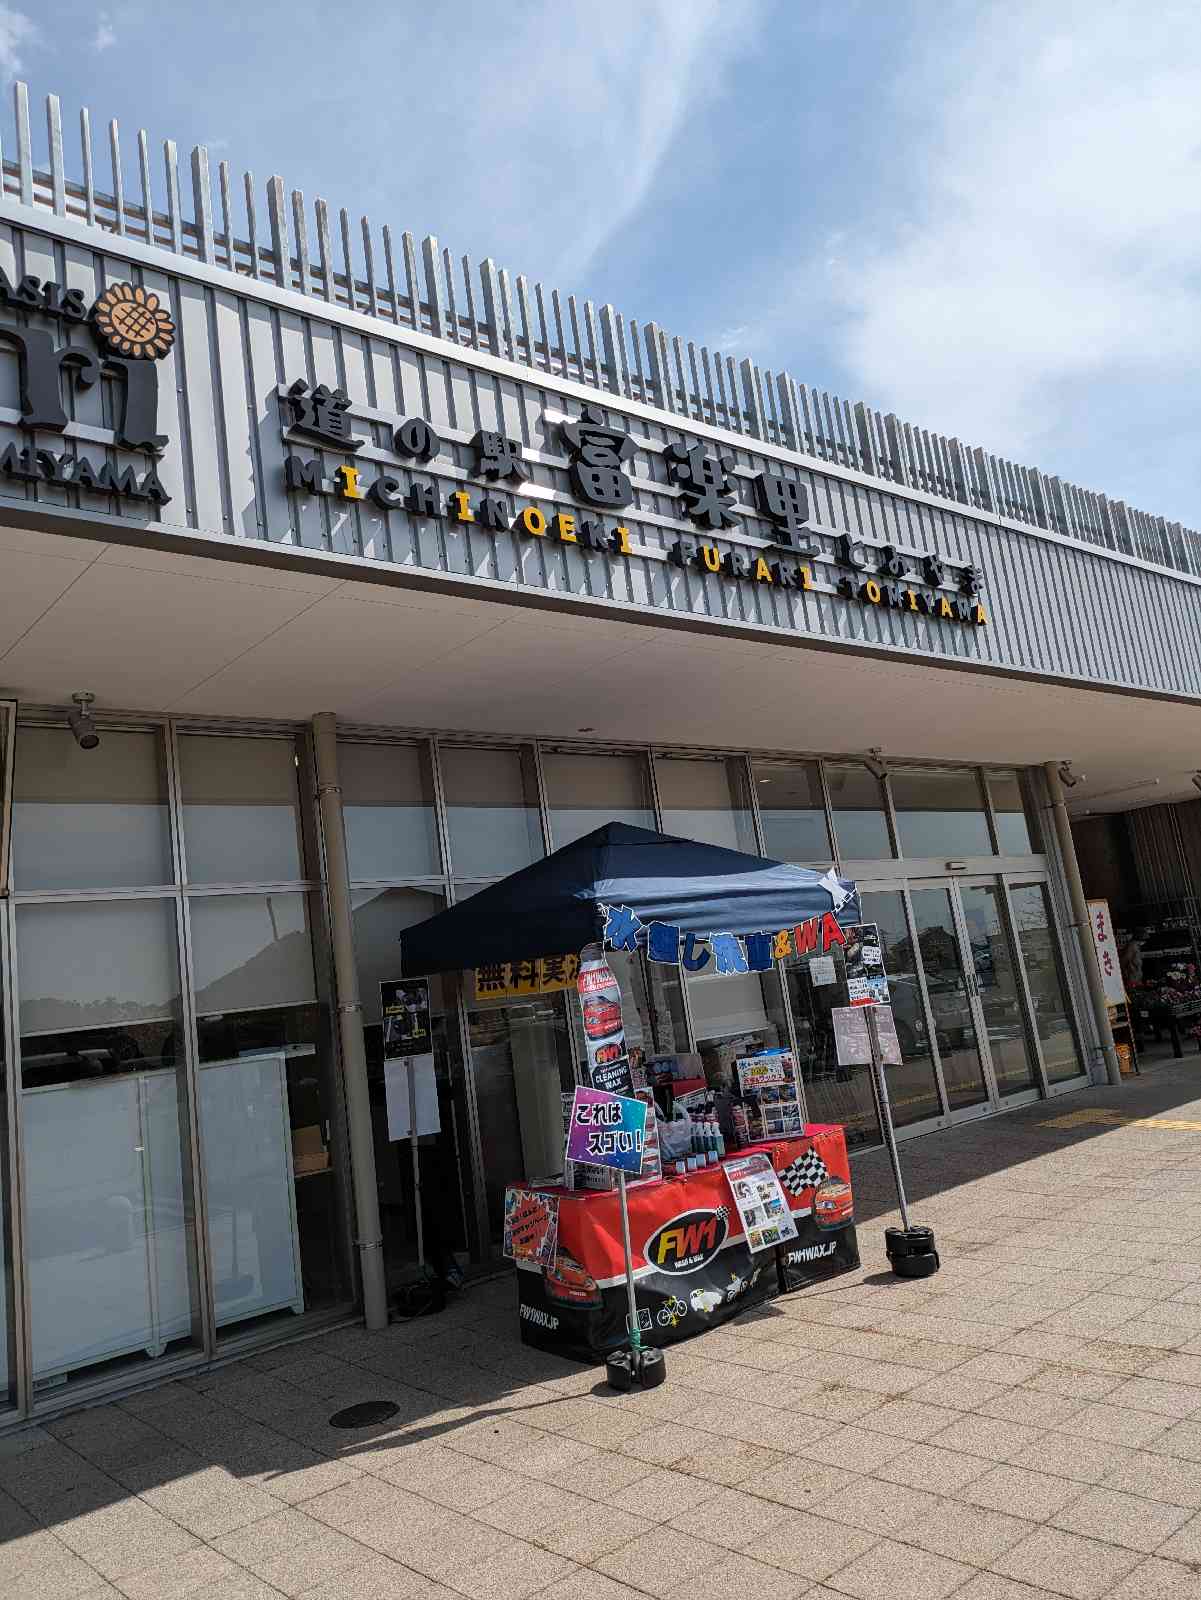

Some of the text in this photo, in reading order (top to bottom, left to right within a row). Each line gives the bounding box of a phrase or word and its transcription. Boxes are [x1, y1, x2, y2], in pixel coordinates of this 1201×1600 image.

[285, 455, 988, 625] MICHINOEKI FURARI TOMIYAMA
[595, 1066, 628, 1084] CLEANING
[605, 1078, 622, 1090] WAX
[576, 1102, 623, 1126] これは
[657, 1217, 717, 1264] FW1
[788, 1240, 837, 1265] FW1WAX.JP
[519, 1302, 560, 1330] FW1WAX.JP
